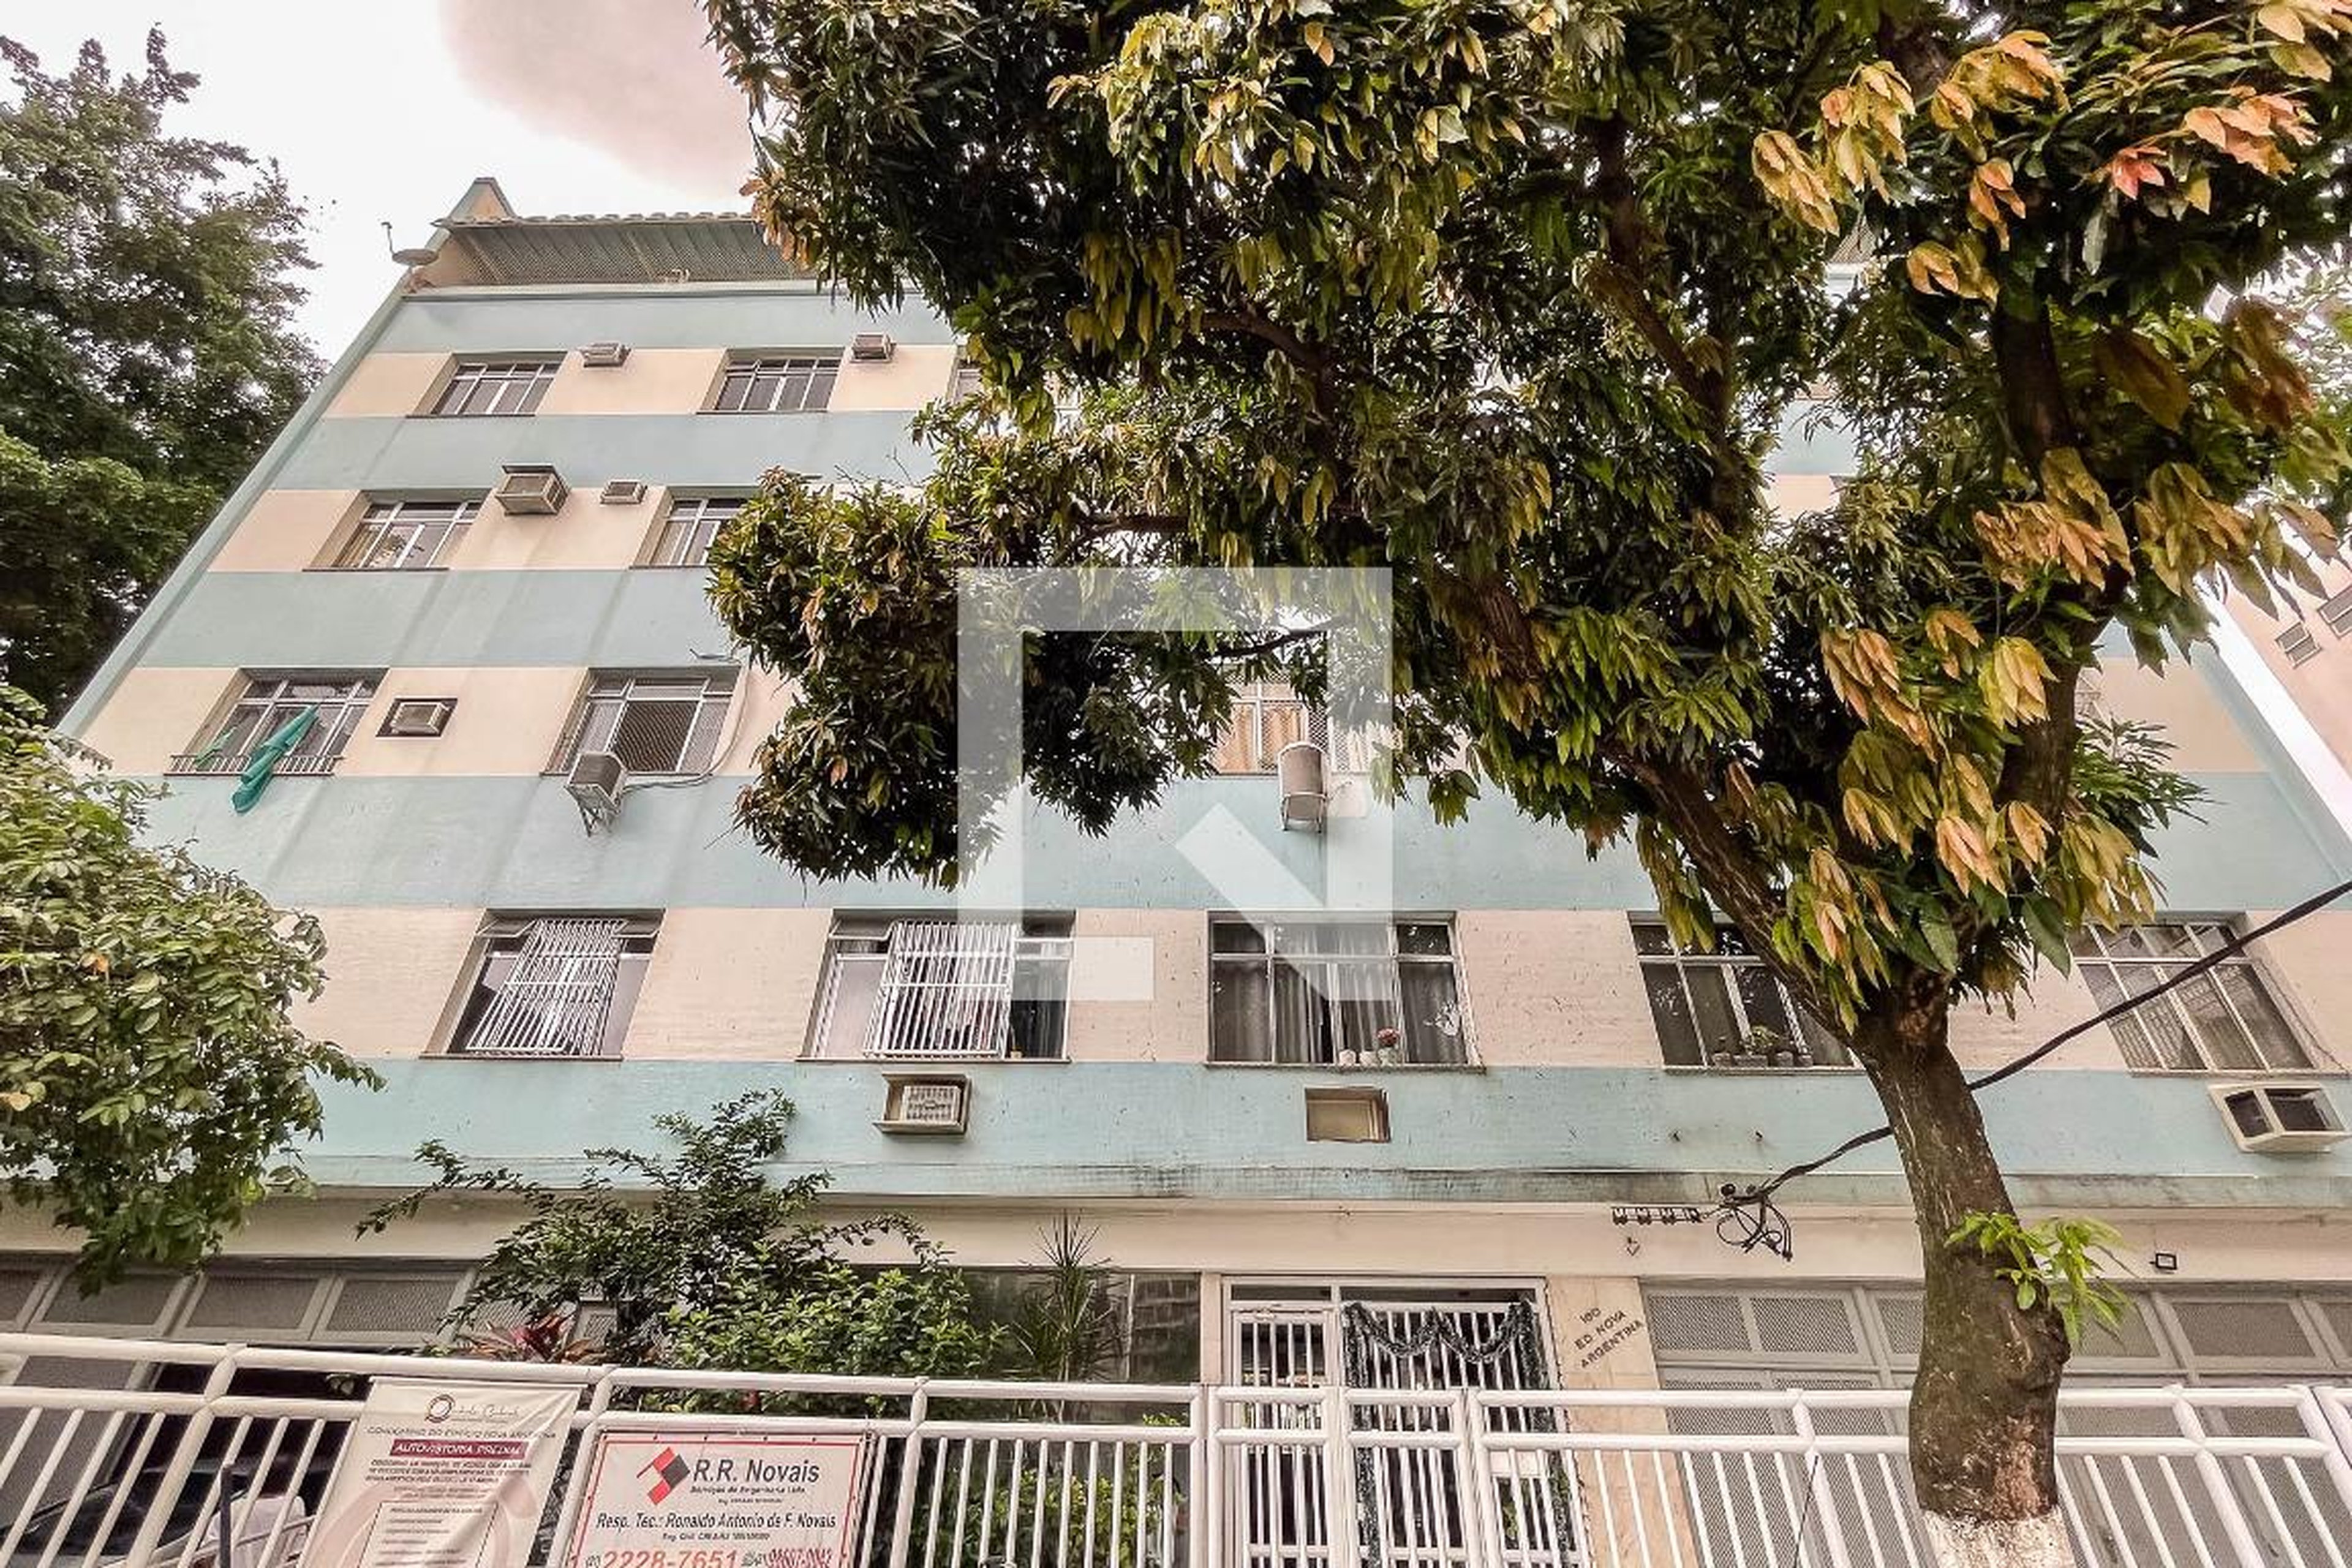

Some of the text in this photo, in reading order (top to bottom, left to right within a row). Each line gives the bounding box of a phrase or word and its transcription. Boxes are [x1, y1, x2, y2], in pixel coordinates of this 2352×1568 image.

[1596, 1310, 1626, 1335] NOVA
[1581, 1320, 1644, 1368] ARGENTINA
[693, 1459, 820, 1483] R.R. Novais
[596, 1513, 630, 1532] Resp.
[665, 1513, 716, 1528] Ronaldo
[717, 1512, 765, 1528] Antonio
[767, 1512, 782, 1528] de
[783, 1513, 793, 1528] F.
[796, 1512, 837, 1528] Novais
[603, 1551, 737, 1568] 2228-7651
